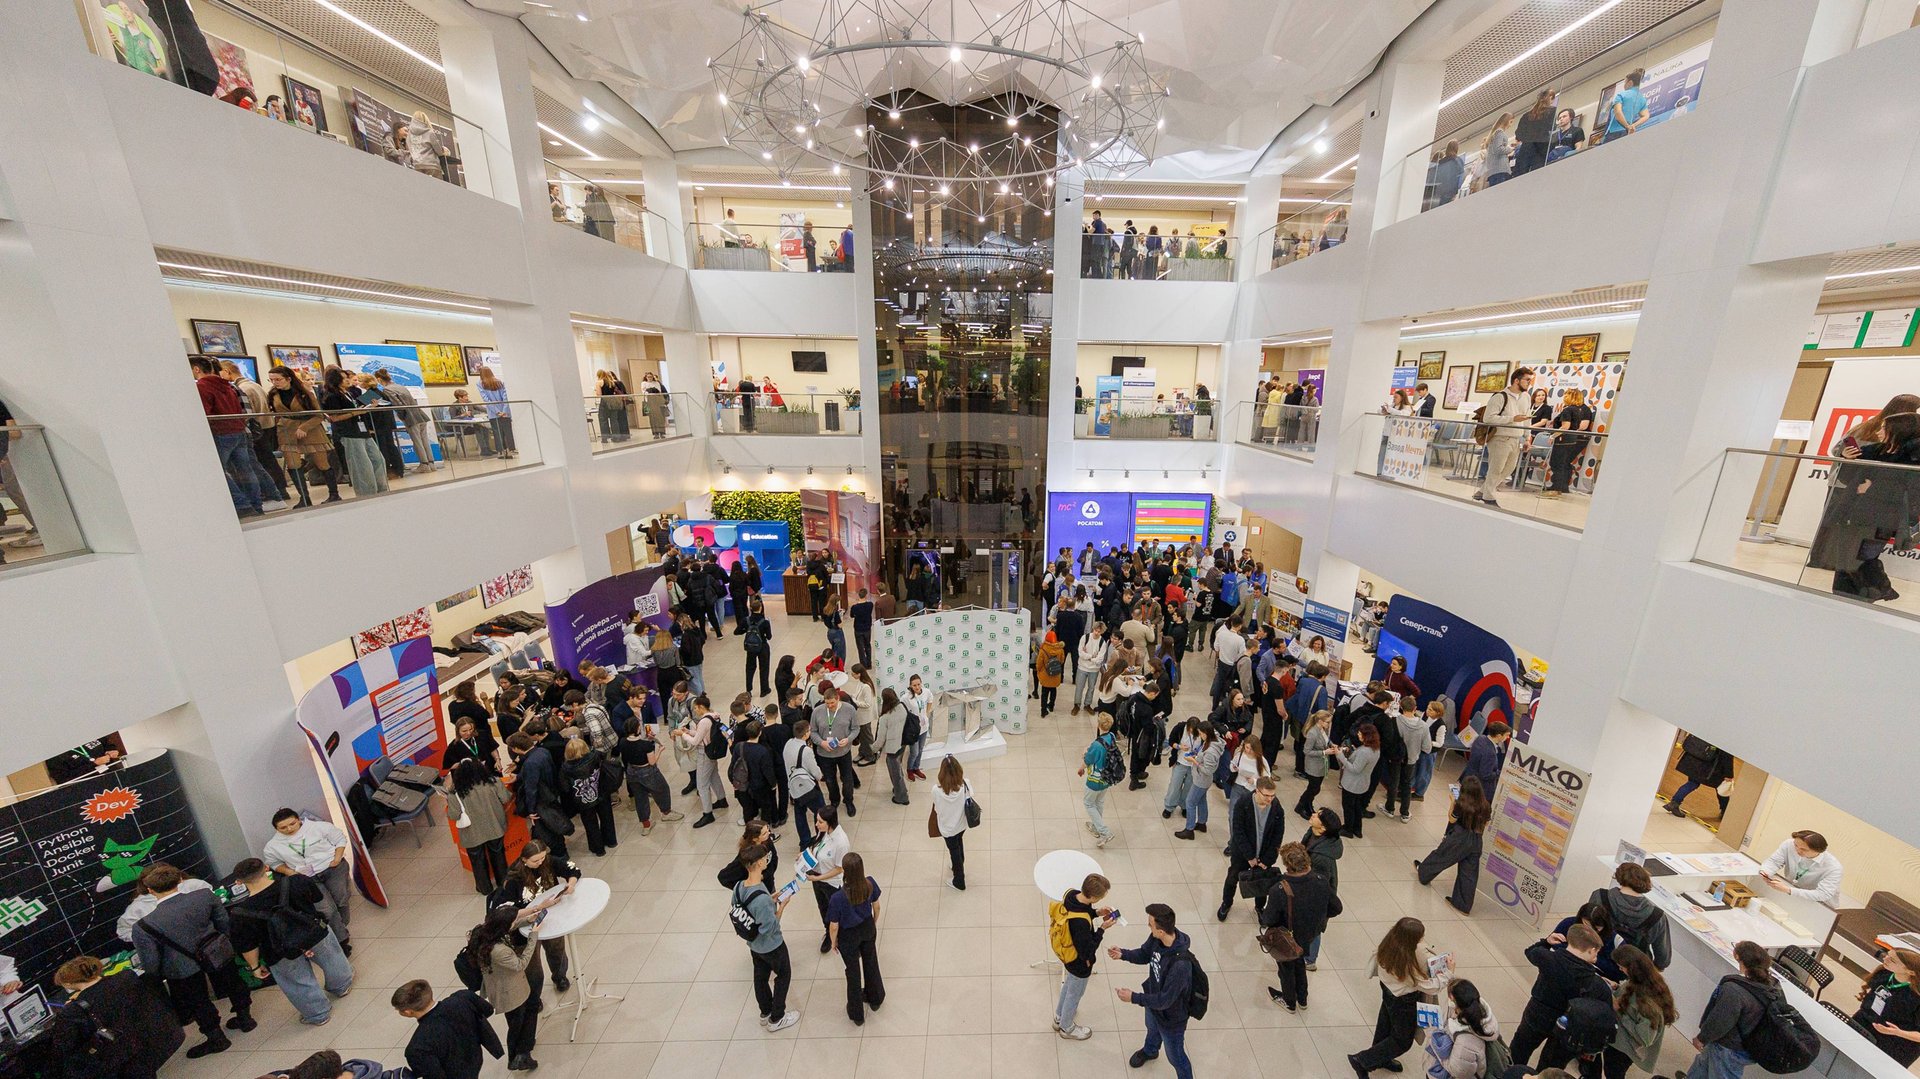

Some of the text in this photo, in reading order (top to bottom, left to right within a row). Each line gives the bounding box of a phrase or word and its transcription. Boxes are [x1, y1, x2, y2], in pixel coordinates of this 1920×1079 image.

[1387, 440, 1425, 456] Завод Мечты
[583, 617, 610, 635] карьера
[1399, 616, 1443, 638] Северсталь
[580, 632, 597, 649] новой
[1510, 747, 1583, 792] МКФ
[1506, 769, 1577, 807] РАСПИСАНИЕ АКТИВНОСТЕЙ
[1508, 763, 1579, 800] ПОТОК ВОЗМОЖНОСТЕЙ
[96, 799, 129, 813] Dev
[37, 826, 89, 849] Python
[43, 834, 95, 859] Ansible
[45, 844, 97, 869] Docker
[51, 859, 85, 877] Junit
